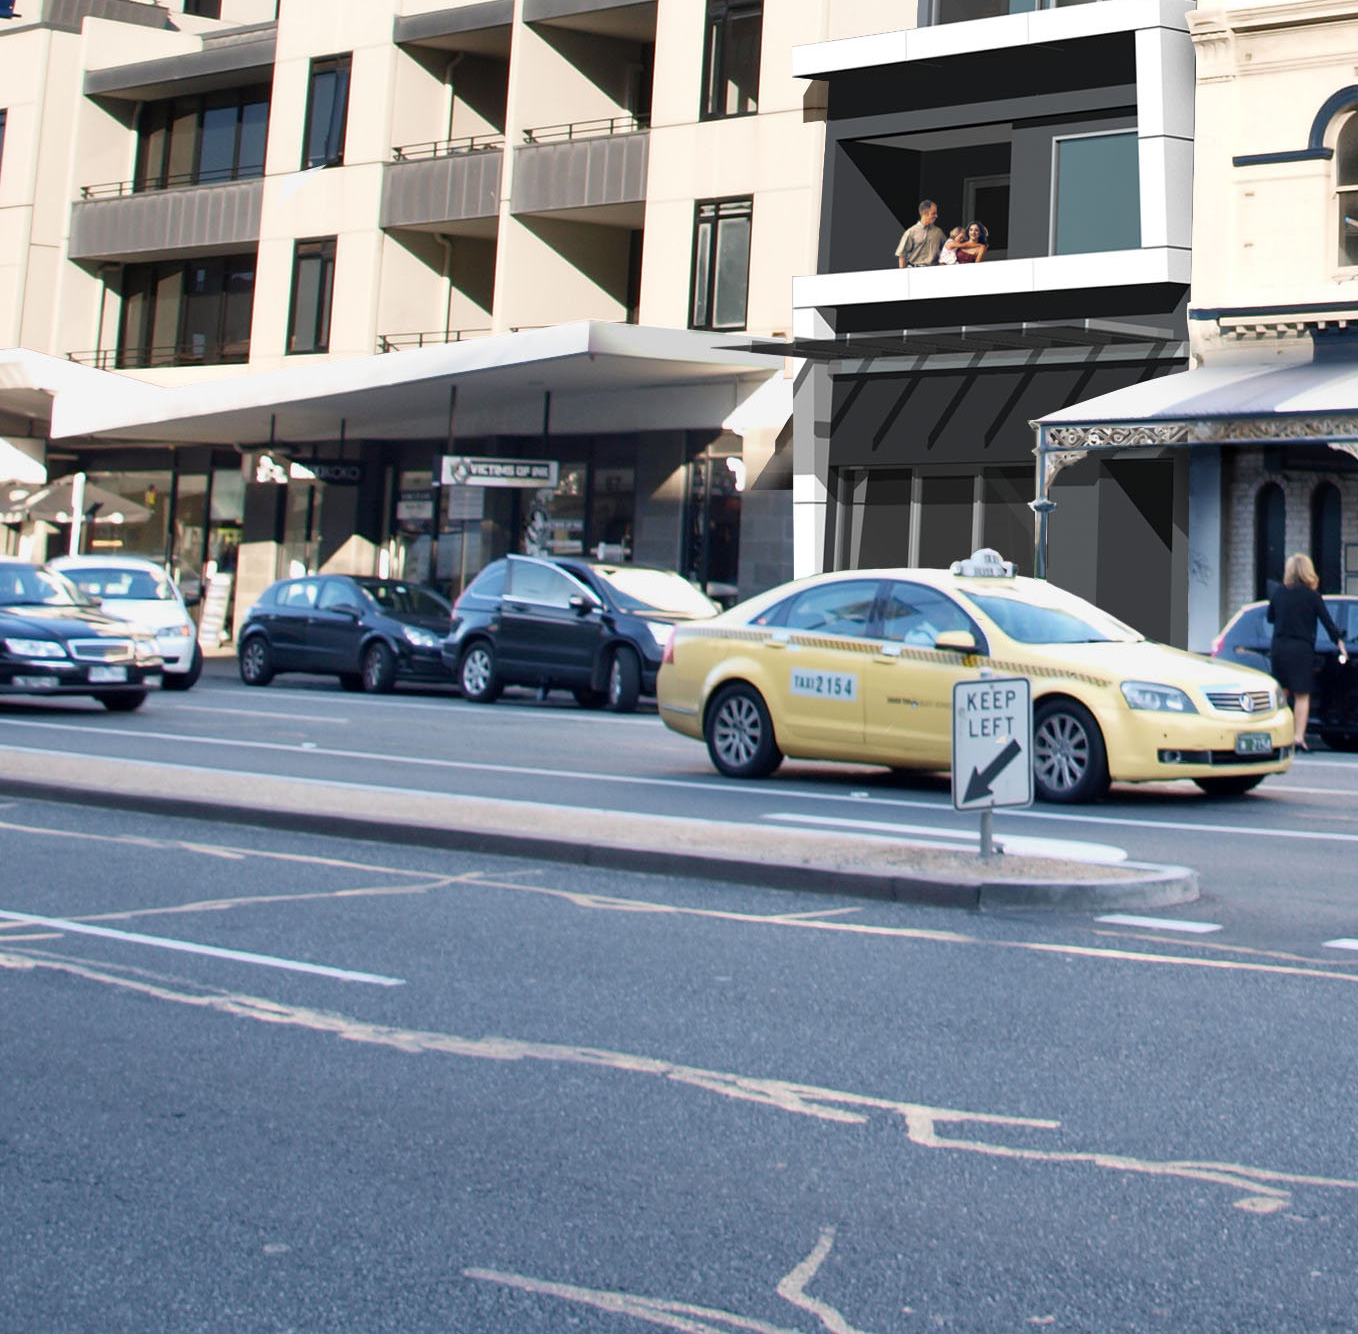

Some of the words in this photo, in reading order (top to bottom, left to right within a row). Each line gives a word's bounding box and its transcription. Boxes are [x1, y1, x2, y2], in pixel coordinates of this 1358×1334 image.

[794, 675, 814, 690] TAXI
[816, 676, 852, 695] 2154
[967, 690, 1016, 712] KEEP
[969, 716, 1014, 738] LEFT
